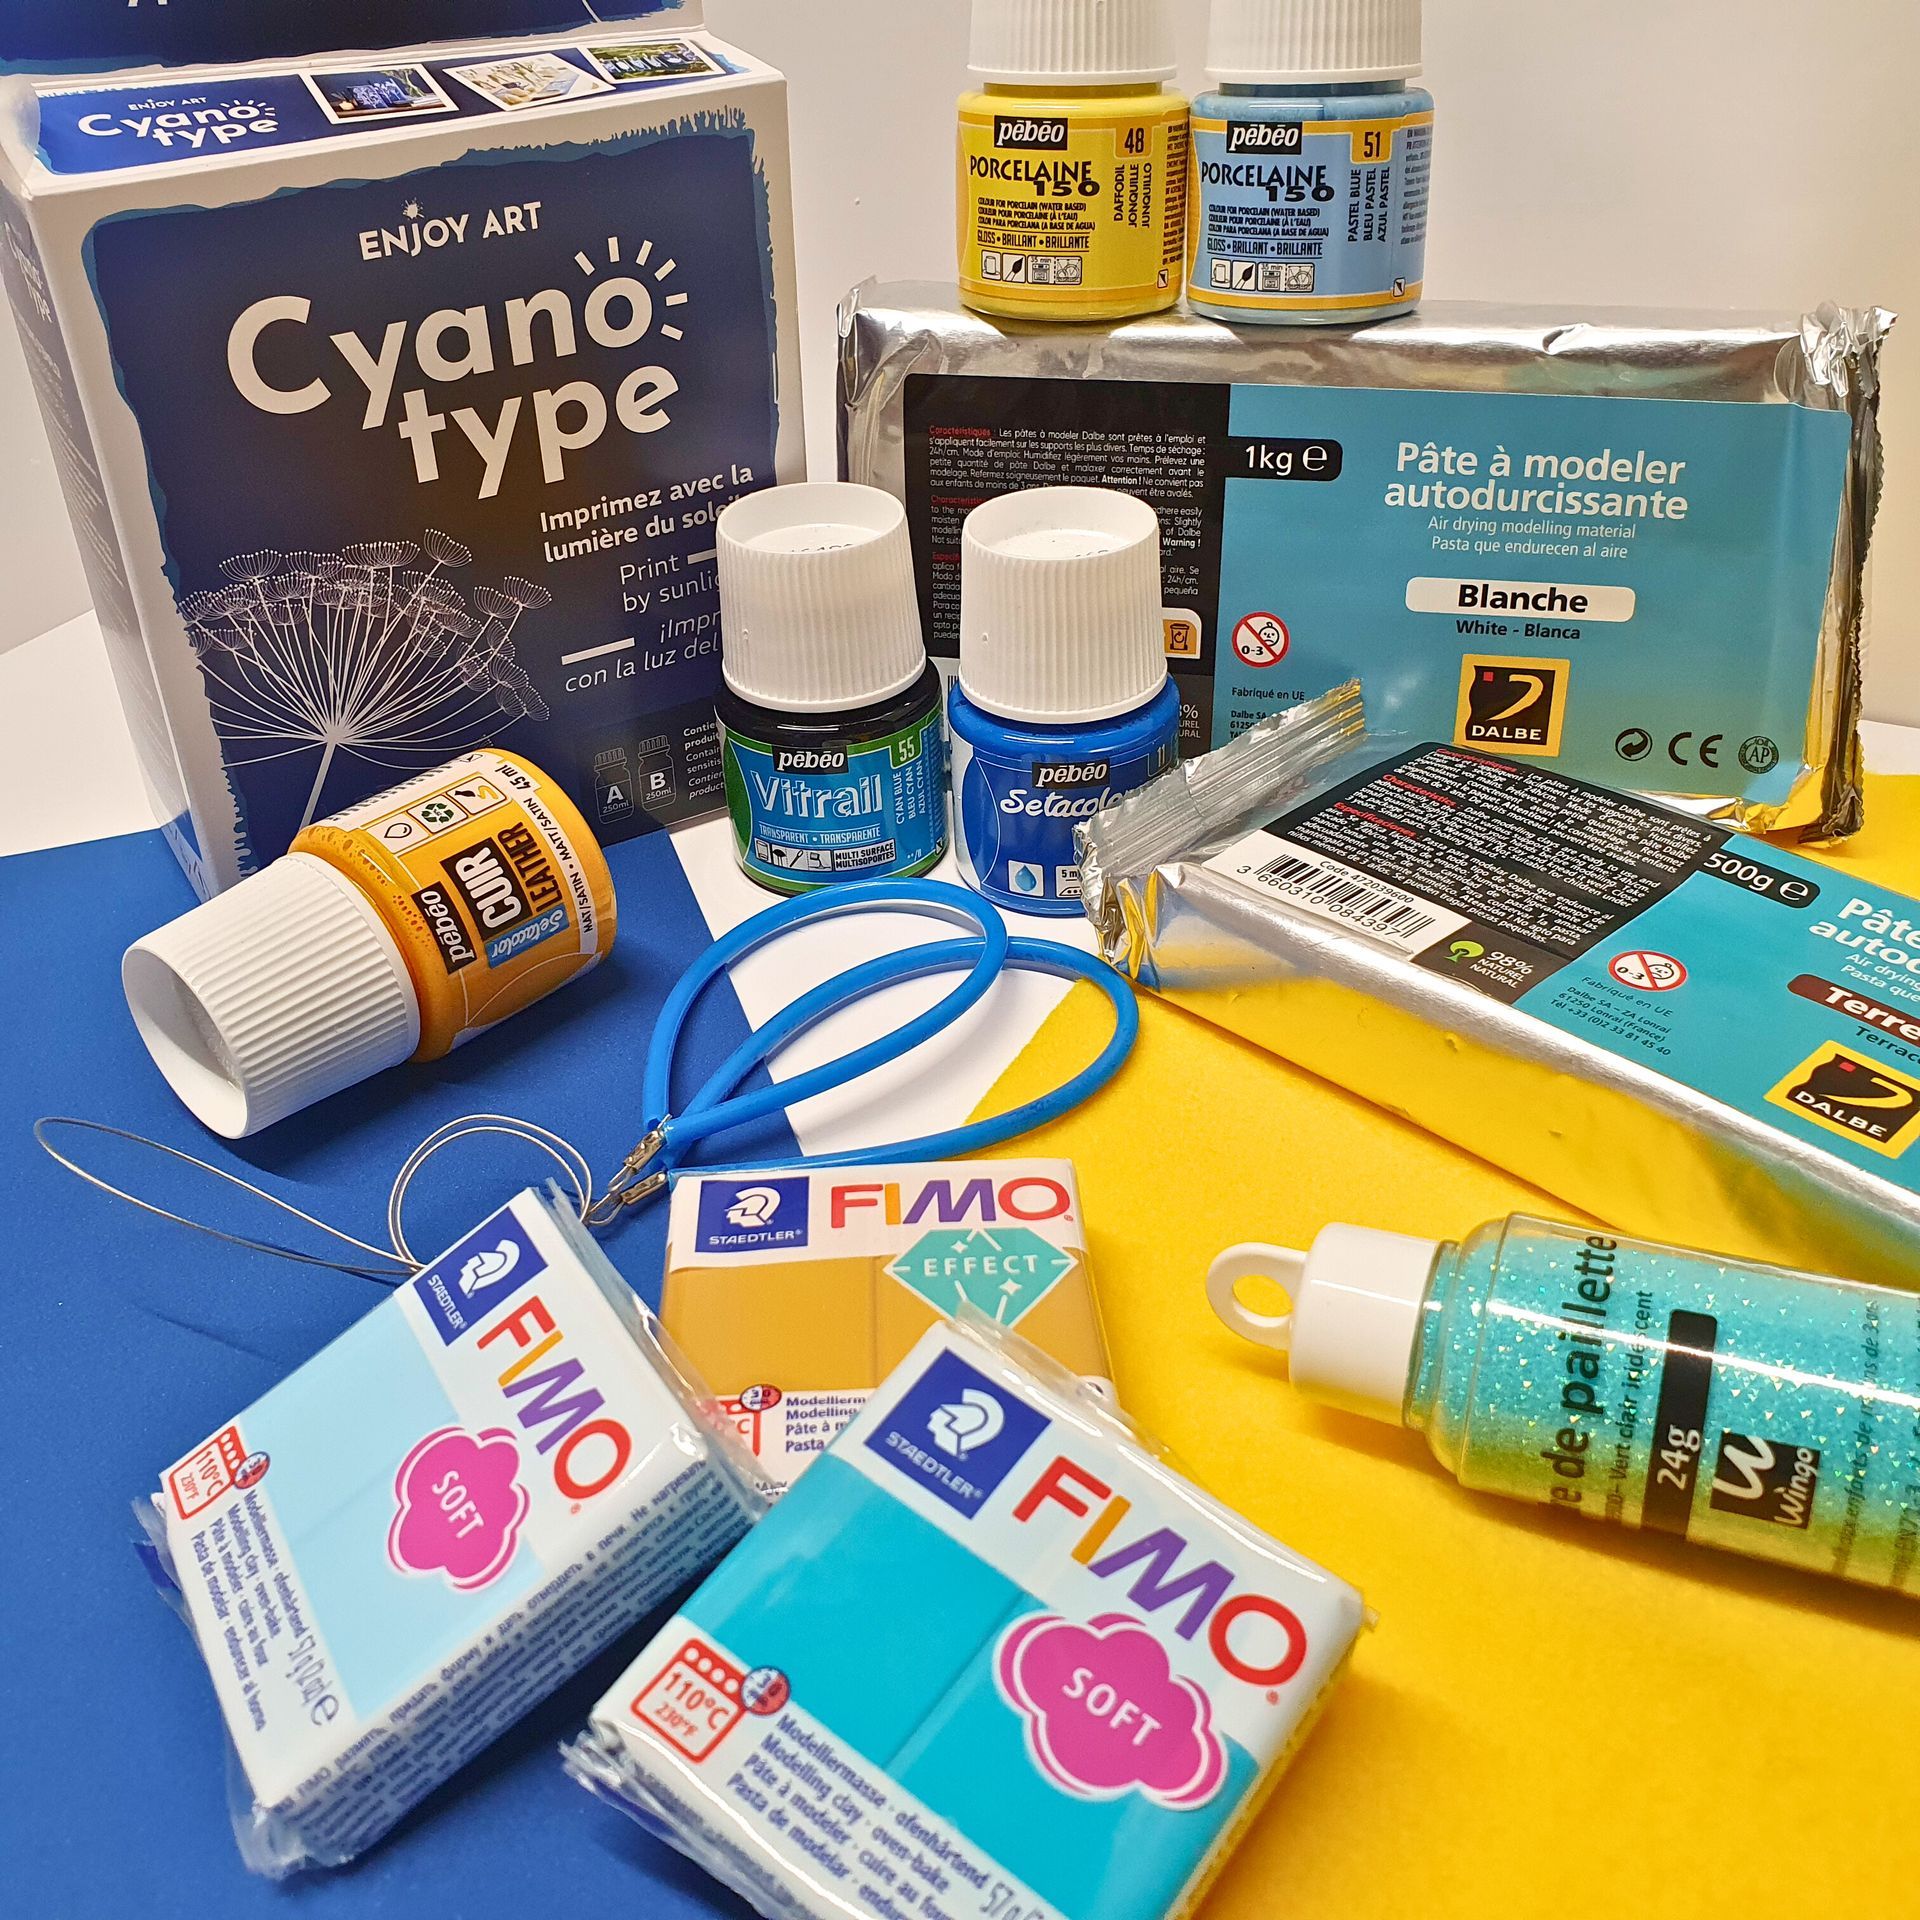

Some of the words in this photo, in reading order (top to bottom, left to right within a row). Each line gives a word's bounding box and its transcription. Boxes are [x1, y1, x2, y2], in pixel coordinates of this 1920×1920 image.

[128, 99, 176, 111] ENJOY
[181, 97, 208, 106] ART
[78, 103, 261, 138] Cyano
[151, 118, 279, 148] type
[1124, 127, 1145, 154] 48
[1364, 131, 1382, 158] 51
[970, 155, 1092, 182] PORCELAINE
[1201, 161, 1327, 187] PORCELAINE
[1033, 181, 1100, 197] 150
[1114, 165, 1126, 221] DAFFODIL
[1128, 164, 1139, 228] JONQUILLE
[1141, 162, 1152, 228] JUNQUILLO
[1265, 185, 1335, 202] 150
[1366, 167, 1377, 210] PASTEL
[1380, 166, 1390, 209] PASTEL
[1007, 200, 1038, 210] PORCELAIN
[358, 214, 470, 261] ENJOY
[482, 201, 542, 239] ART
[1348, 200, 1360, 242] PASTEL
[1363, 213, 1373, 241] BLEU
[1377, 211, 1388, 242] AZUL
[978, 230, 996, 244] GLOSS
[1002, 233, 1037, 247] BRILLANT
[1045, 236, 1090, 248] BRILLANTE
[1207, 238, 1226, 251] GLOSS
[1233, 240, 1268, 254] BRILLANT
[1277, 242, 1323, 256] BRILLANTE
[226, 276, 653, 430] Cyano
[398, 365, 679, 500] type
[1108, 433, 1125, 442] sont
[1244, 444, 1294, 476] 1kg
[1397, 441, 1479, 477] Pâte
[1489, 445, 1512, 479] à
[1524, 448, 1687, 486] modeler
[540, 489, 663, 533] Imprimez
[670, 473, 725, 502] avec
[731, 464, 754, 486] la
[1384, 479, 1688, 521] autodurcissante
[544, 527, 639, 563] lumière
[645, 514, 675, 539] du
[682, 493, 740, 529] sole
[1428, 515, 1450, 532] Air
[1452, 517, 1498, 538] drying
[1501, 519, 1572, 540] modelling
[1576, 523, 1636, 540] material
[1431, 536, 1472, 553] Pasta
[1474, 541, 1501, 556] que
[1504, 539, 1579, 558] endurecen
[1583, 542, 1597, 558] al
[1599, 544, 1629, 560] aire
[620, 554, 680, 585] Print
[623, 591, 651, 614] by
[1457, 583, 1590, 615] Blanche
[1455, 619, 1508, 637] White
[1524, 622, 1581, 640] Blanca
[565, 669, 608, 692] con
[616, 658, 637, 680] la
[644, 648, 677, 672] luz
[684, 632, 719, 660] del
[1241, 645, 1264, 656] 0-3
[1231, 687, 1275, 700] Fabriqué
[1277, 690, 1290, 699] en
[1291, 690, 1305, 701] UE
[1472, 725, 1542, 741] DALBE
[899, 736, 914, 762] 55
[1668, 731, 1723, 768] CE
[494, 763, 518, 777] ml
[508, 775, 533, 792] 45
[650, 772, 666, 790] B
[893, 771, 901, 796] BLUE
[905, 767, 914, 794] CYAN
[916, 760, 924, 789] CYAN
[602, 801, 629, 814] 250ml
[606, 786, 624, 804] A
[645, 787, 672, 801] 250ml
[750, 770, 882, 818] Vitrail
[908, 796, 916, 820] BLEU
[896, 798, 905, 824] CYAN
[523, 797, 572, 861] MATT/SATIN
[759, 824, 809, 844] TRANSPARENT
[820, 827, 881, 844] TRANSPARENTE
[497, 821, 563, 913] LEATHER
[835, 850, 859, 861] MULTI
[861, 843, 894, 857] SURFACE
[835, 852, 895, 868] MULTISOPORTES
[1319, 860, 1350, 877] Code
[1350, 874, 1414, 903] 472039600
[1704, 851, 1774, 892] 500g
[454, 846, 522, 930] CUIR
[570, 872, 594, 933] MAT/SATIN
[1236, 865, 1252, 875] 3
[1258, 873, 1325, 905] 660310
[1328, 903, 1401, 937] 084397
[491, 909, 563, 959] Setacolor
[1837, 898, 1920, 949] Pâte
[1477, 958, 1525, 983] NATUREL
[1486, 951, 1534, 975] 98%
[1617, 966, 1645, 981] 0-3
[1846, 953, 1873, 967] Air
[1469, 963, 1518, 990] NATURAL
[1841, 964, 1887, 989] Pasta
[1889, 985, 1920, 1003] que
[1581, 976, 1634, 1005] Fabriqué
[1636, 998, 1651, 1009] en
[1655, 1006, 1673, 1018] UE
[1825, 986, 1920, 1041] Terre
[1794, 1090, 1888, 1137] DALBE
[830, 1177, 1070, 1229] FIMO
[924, 1255, 1038, 1277] EFFECT
[476, 1295, 632, 1499] FIMO
[785, 1422, 817, 1436] Pâte
[822, 1420, 830, 1433] à
[785, 1438, 825, 1453] Pasta
[1540, 1426, 1589, 1481] de
[1657, 1424, 1701, 1490] 24g
[432, 1470, 485, 1539] SOFT
[1012, 1456, 1307, 1686] FIMO
[1061, 1668, 1162, 1747] SOFT
[777, 1713, 887, 1808] Modelliermasse
[727, 1773, 768, 1812] Pasta
[788, 1826, 850, 1878] modelar
[761, 1734, 832, 1800] Modelling
[832, 1792, 863, 1825] clay
[872, 1826, 950, 1893] oven-bake
[789, 1792, 851, 1845] modeler
